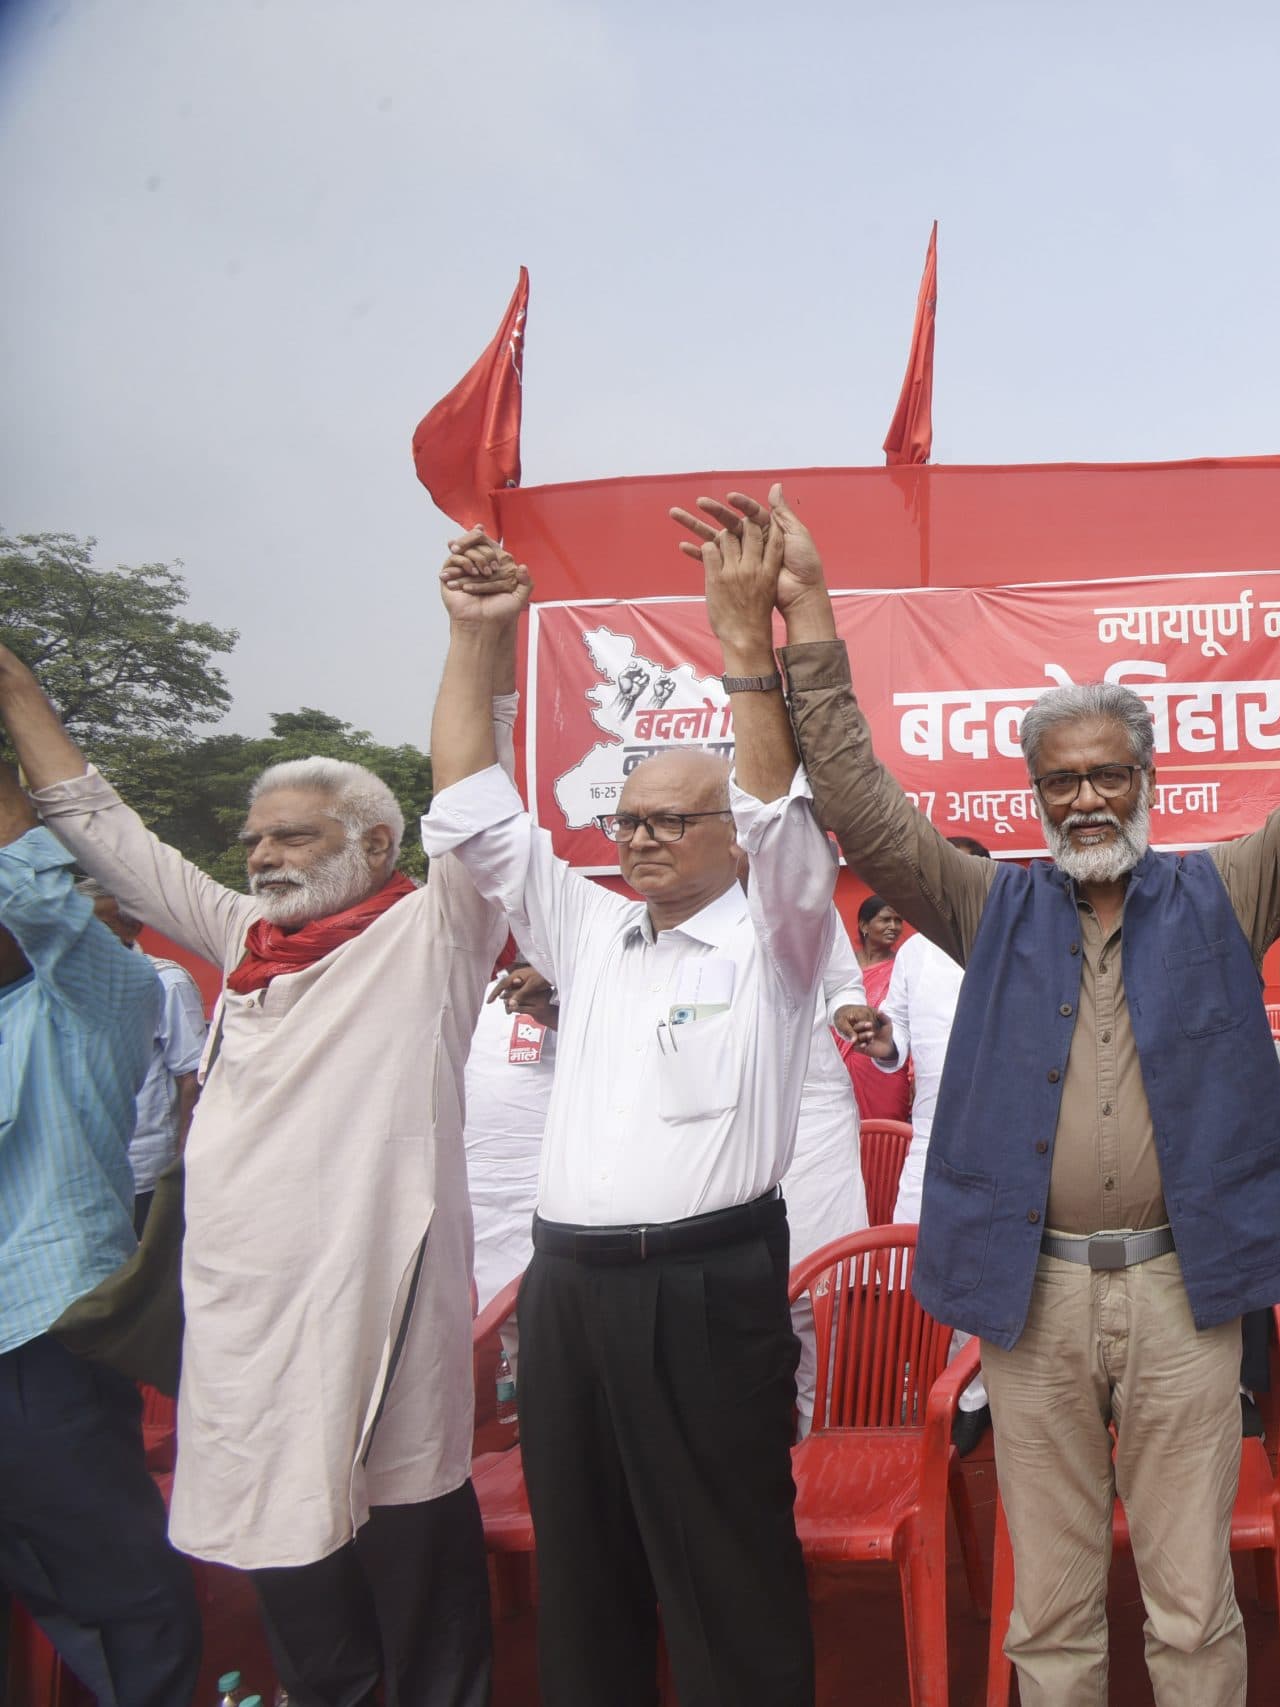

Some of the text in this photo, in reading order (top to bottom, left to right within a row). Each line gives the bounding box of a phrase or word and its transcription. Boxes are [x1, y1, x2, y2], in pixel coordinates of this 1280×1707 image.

[1094, 590, 1254, 657] न्यायपूर्ण
[634, 697, 718, 741] बदलो
[590, 786, 617, 800] 16-25
